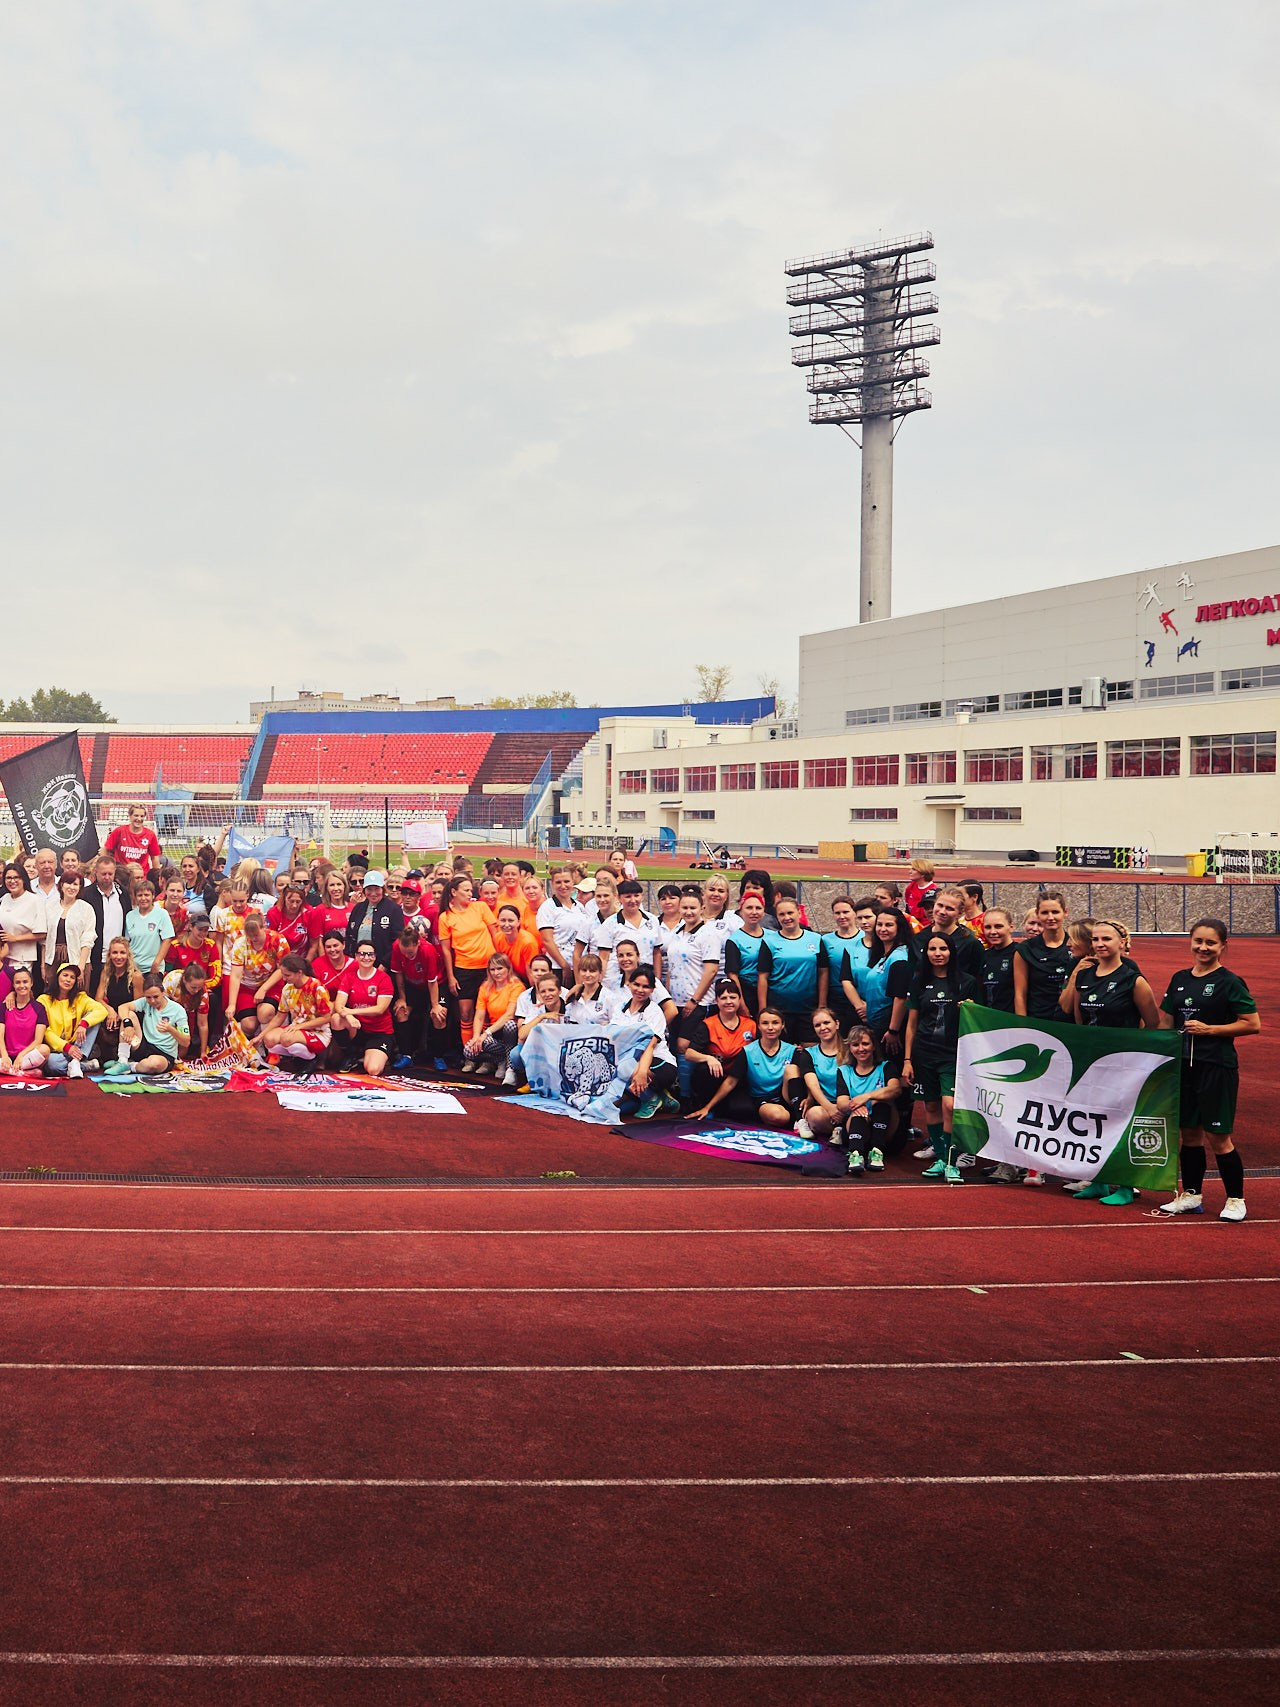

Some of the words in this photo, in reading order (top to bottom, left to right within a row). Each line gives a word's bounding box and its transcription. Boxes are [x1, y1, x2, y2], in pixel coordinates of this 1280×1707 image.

[14, 803, 39, 855] ИВАНОВО
[566, 1038, 609, 1056] IRBIS
[975, 1086, 1006, 1118] 2025
[1017, 1099, 1108, 1139] ДУСТ
[1014, 1130, 1102, 1164] moms
